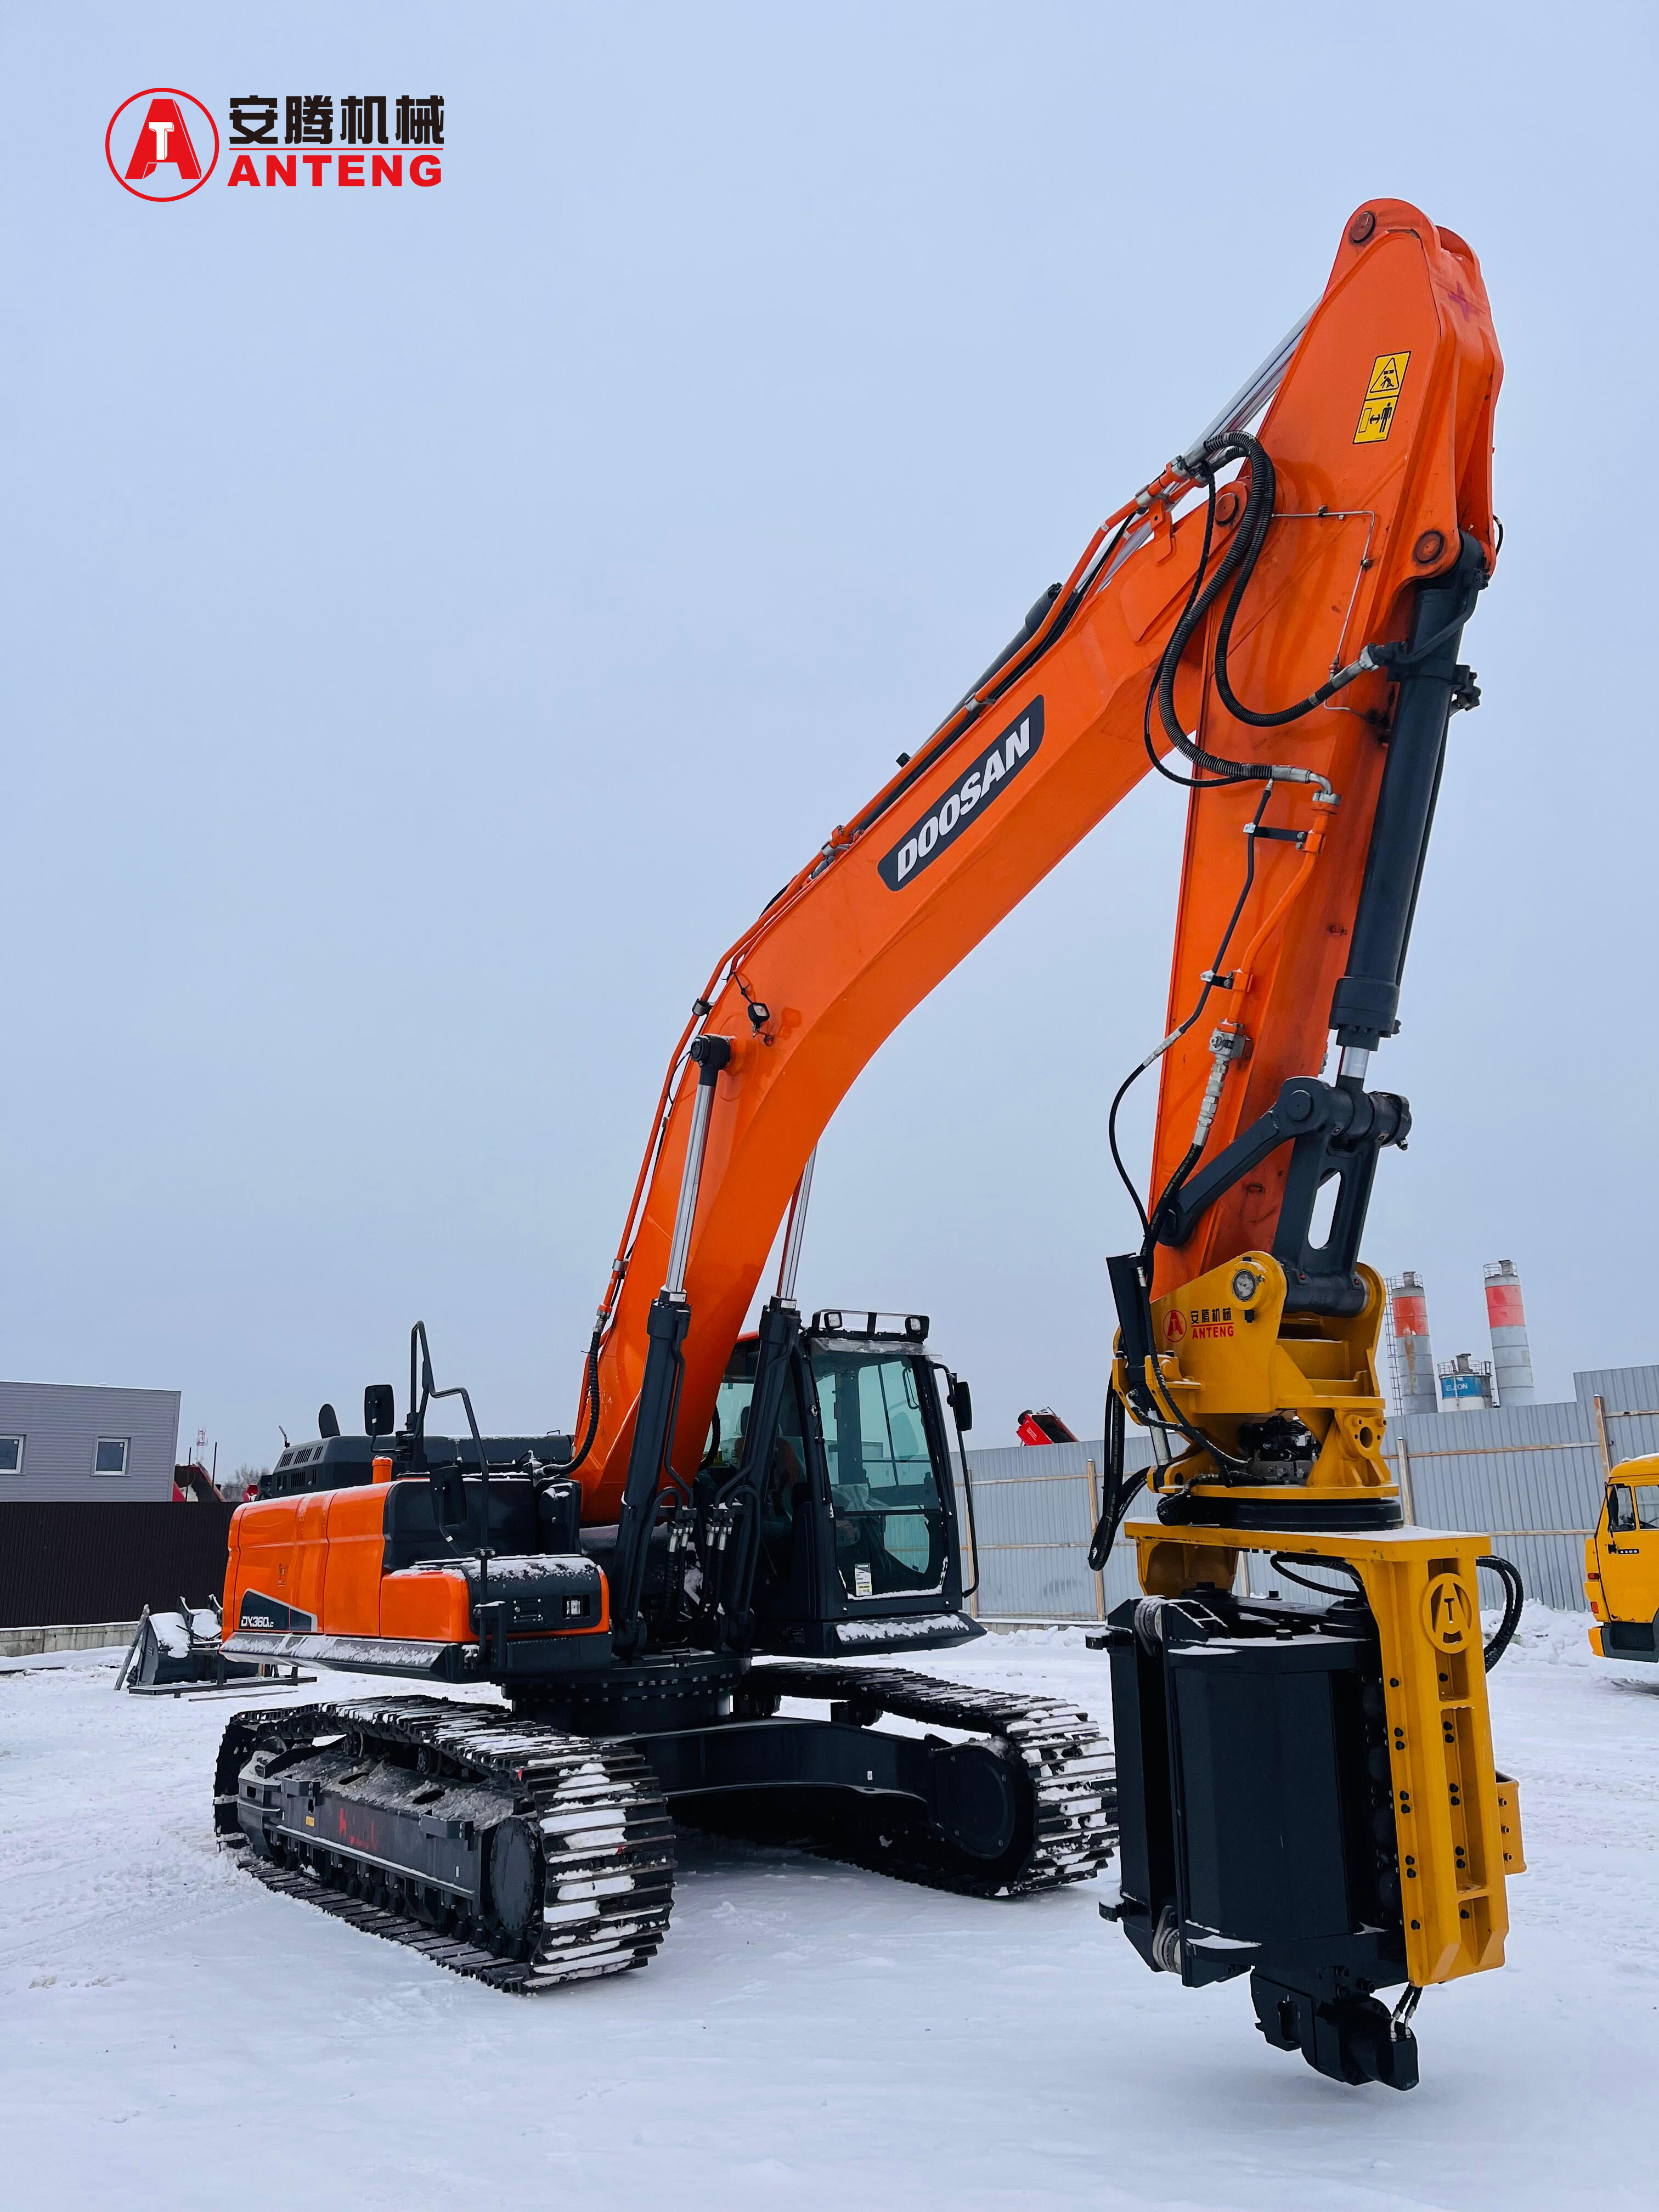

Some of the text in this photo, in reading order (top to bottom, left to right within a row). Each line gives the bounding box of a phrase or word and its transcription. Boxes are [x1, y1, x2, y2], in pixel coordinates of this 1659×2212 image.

[898, 717, 1030, 883] DOOSAN
[1192, 1325, 1234, 1339] ANTENG
[1446, 1383, 1469, 1392] ELON
